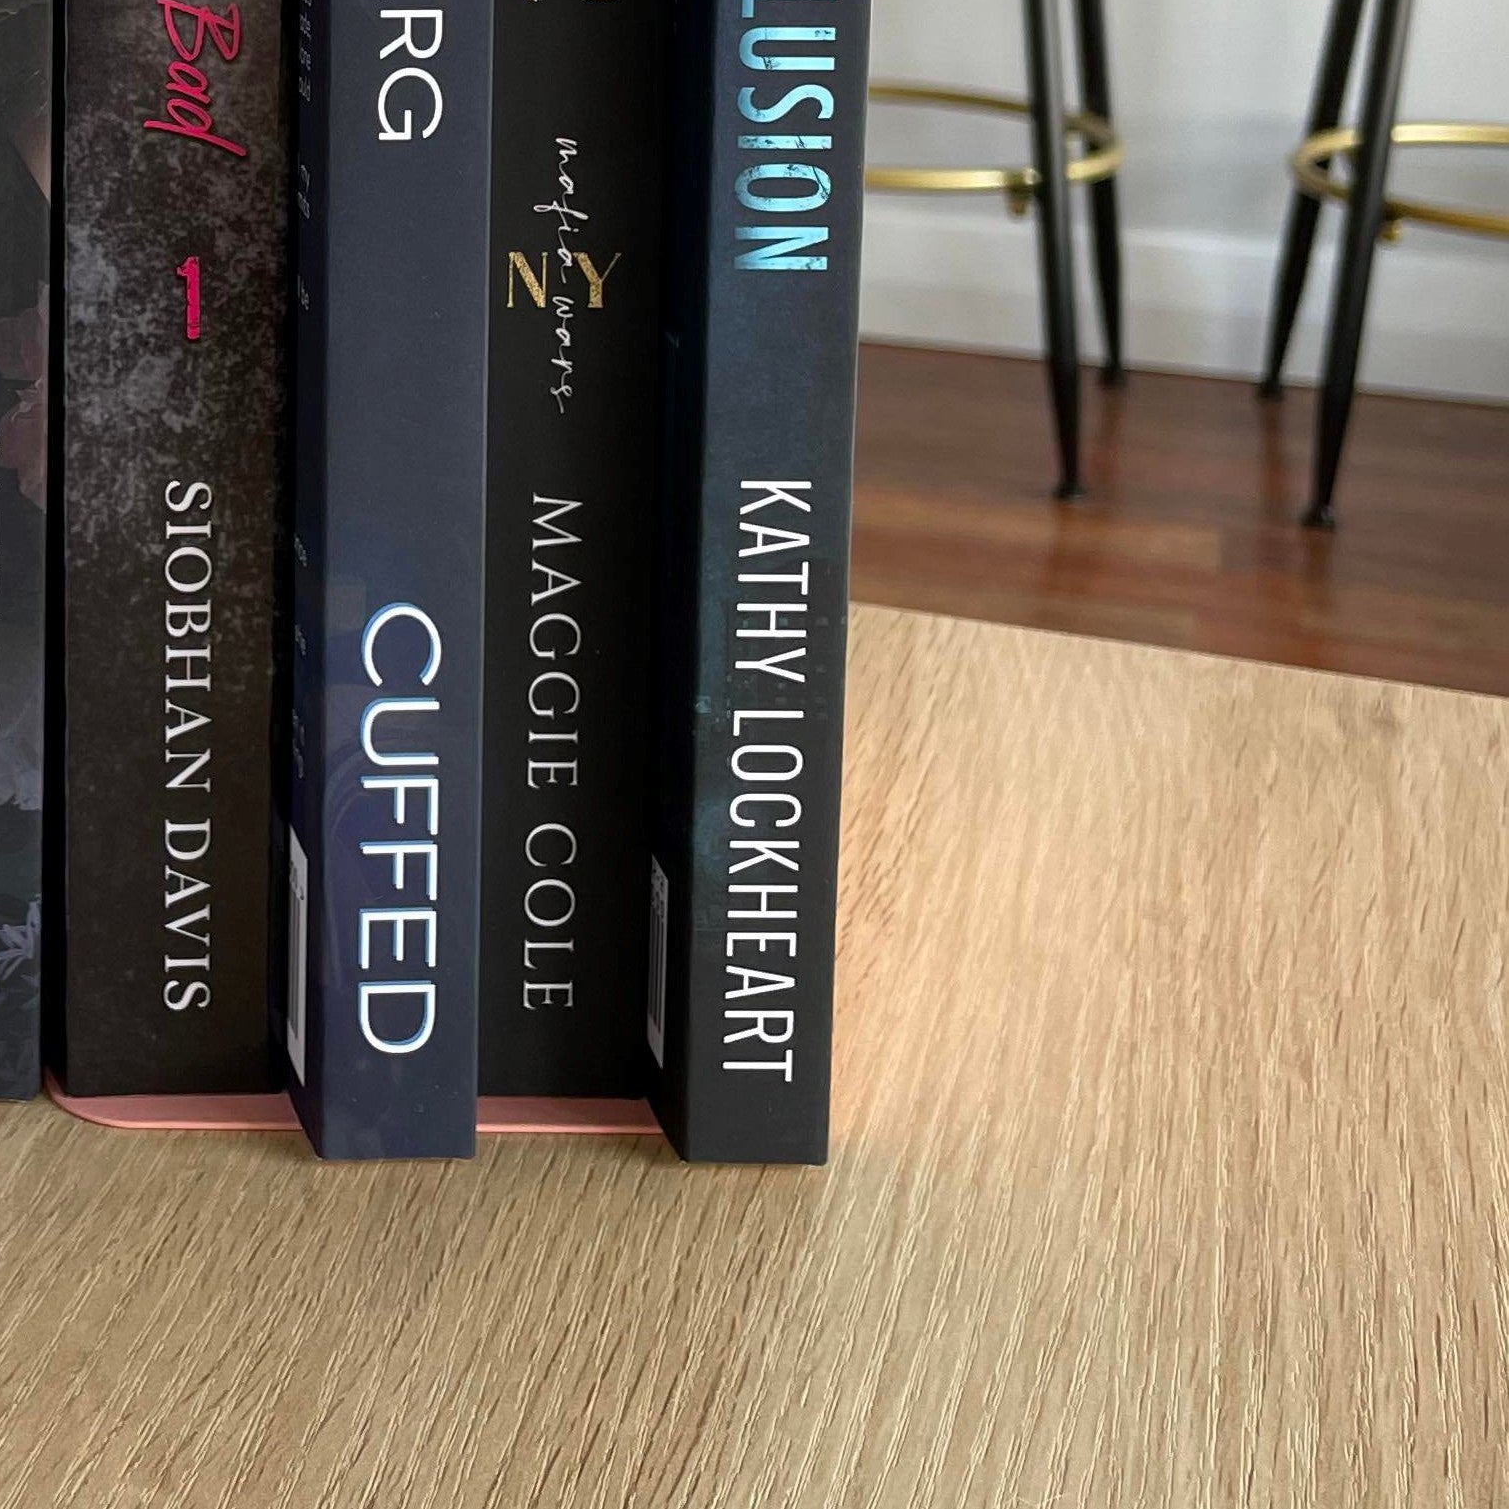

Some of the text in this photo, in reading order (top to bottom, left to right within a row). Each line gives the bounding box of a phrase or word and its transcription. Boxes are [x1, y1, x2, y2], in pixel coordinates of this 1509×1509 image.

[177, 255, 202, 340] 1
[533, 137, 589, 414] mafia wars
[163, 479, 214, 1012] SIOBHAN DAVIS
[358, 601, 443, 1055] CUFFED
[522, 491, 585, 1011] MAGGIE COLE
[722, 479, 814, 1084] KATHY LOCKHEART
